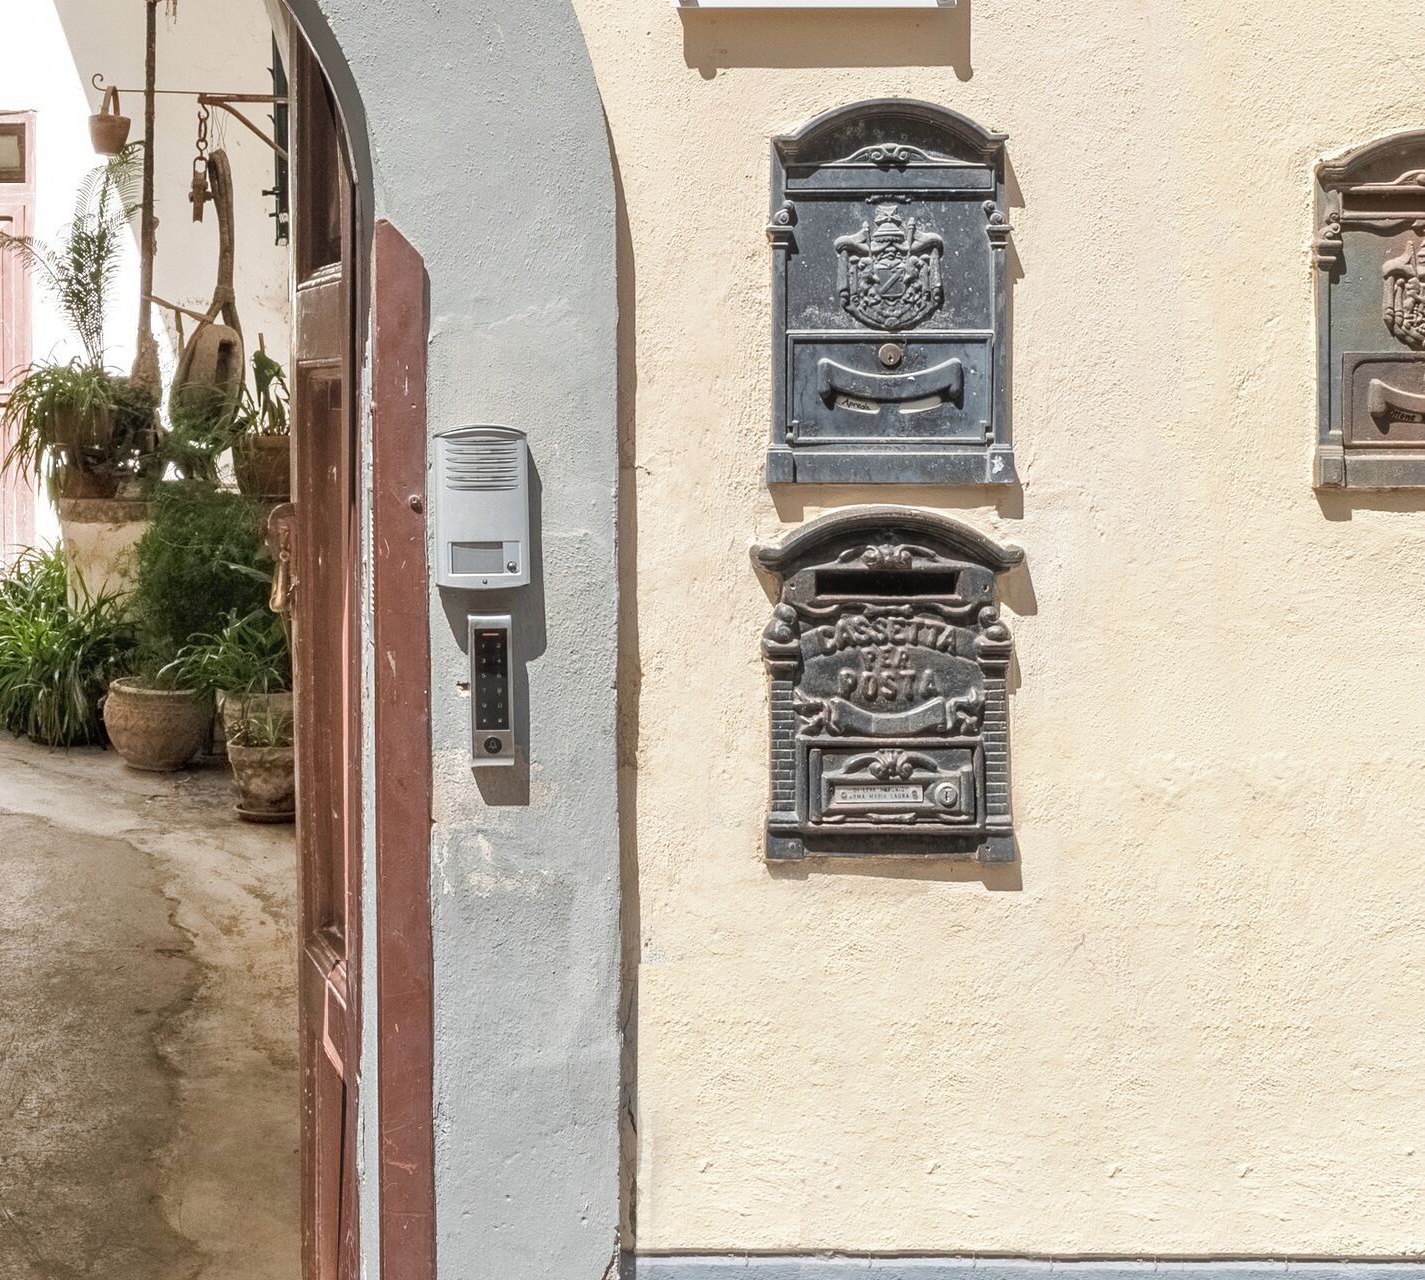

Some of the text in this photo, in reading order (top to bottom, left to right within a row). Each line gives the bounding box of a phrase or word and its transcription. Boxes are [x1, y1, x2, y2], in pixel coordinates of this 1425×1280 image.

[817, 616, 958, 657] CASSETTA
[860, 646, 911, 672] PER
[836, 668, 941, 702] POSTA
